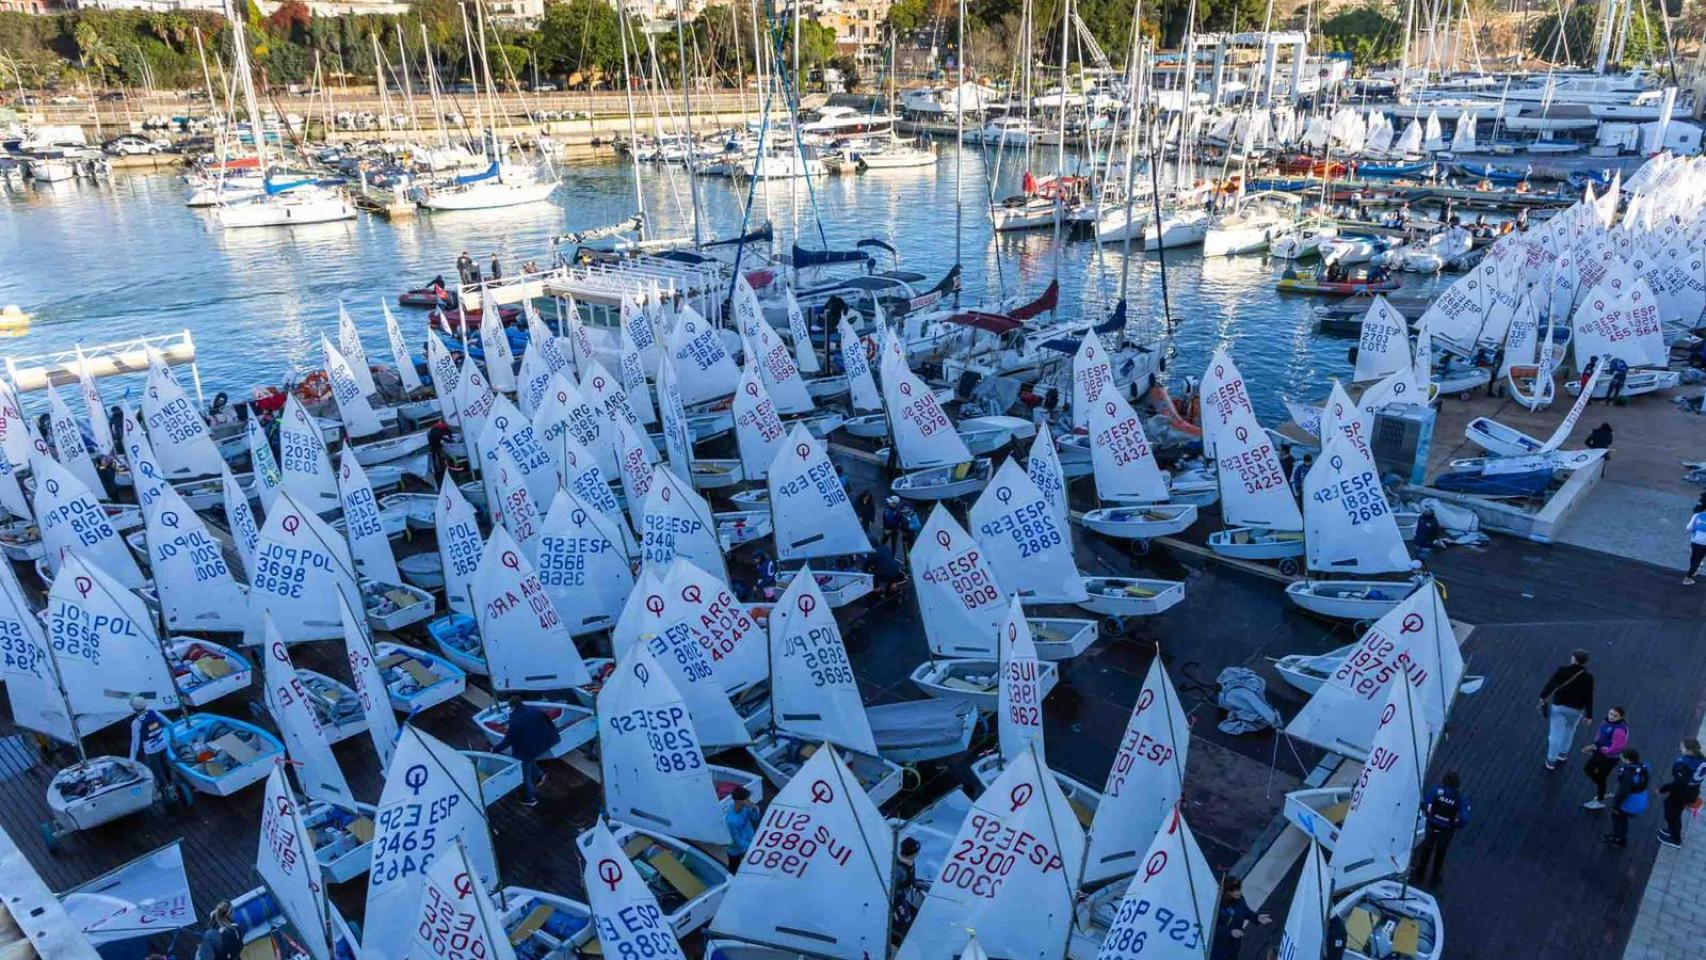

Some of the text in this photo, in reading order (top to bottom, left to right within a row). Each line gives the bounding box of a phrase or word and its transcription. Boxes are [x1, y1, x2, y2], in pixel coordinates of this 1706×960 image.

[1464, 300, 1482, 314] ESP
[1632, 305, 1656, 318] ESP
[1600, 311, 1622, 327] ESP
[694, 330, 712, 348] ESP
[1362, 333, 1389, 344] 2703
[1609, 328, 1631, 342] 455
[700, 350, 726, 372] 3486
[1087, 364, 1108, 378] ESP
[530, 374, 548, 392] ESP
[1219, 380, 1242, 398] ESP
[162, 398, 187, 417] NED
[604, 391, 627, 412] ARG
[914, 394, 934, 412] SUI
[568, 404, 590, 424] ARG
[170, 422, 204, 444] 3366
[514, 426, 534, 448] ESP
[920, 416, 947, 438] 1978
[1111, 418, 1136, 440] ESP
[1344, 422, 1360, 438] SP
[284, 446, 318, 461] 2039
[519, 451, 550, 476] 3449
[1114, 444, 1148, 466] 3432
[1242, 445, 1270, 466] ESP
[808, 461, 832, 482] ESP
[1244, 472, 1283, 494] 3425
[1340, 472, 1372, 495] ESP
[61, 497, 96, 521] POL
[824, 490, 846, 508] 3118
[1014, 500, 1046, 524] ESP
[1348, 502, 1388, 526] 2681
[78, 524, 114, 547] 1518
[447, 522, 476, 542] POL
[672, 516, 702, 534] ESP
[580, 538, 612, 552] ESP
[1018, 531, 1062, 558] 2889
[257, 558, 306, 582] 3698
[300, 550, 335, 573] POL
[540, 554, 584, 570] 3568
[948, 551, 979, 576] ESP
[520, 576, 542, 598] ARG
[961, 585, 998, 610] 1908
[700, 592, 732, 630] ARG
[94, 616, 138, 636] POL
[665, 623, 689, 646] ESP
[808, 626, 841, 647] POL
[711, 617, 751, 662] 4049
[683, 662, 712, 683] 3186
[810, 666, 852, 686] 3695
[1011, 662, 1035, 682] SUI
[1350, 650, 1396, 684] 1975
[648, 707, 684, 731] ESP
[1009, 707, 1039, 726] 1962
[1137, 735, 1172, 766] ESP
[1371, 747, 1399, 772] SUI
[430, 794, 460, 825] ESP
[374, 828, 436, 860] 3465
[756, 830, 818, 858] 1980
[814, 825, 852, 866] SUI
[1013, 831, 1064, 874] ESP
[954, 839, 1016, 877] 2300
[618, 904, 660, 934] ESP
[1114, 899, 1150, 925] ESP
